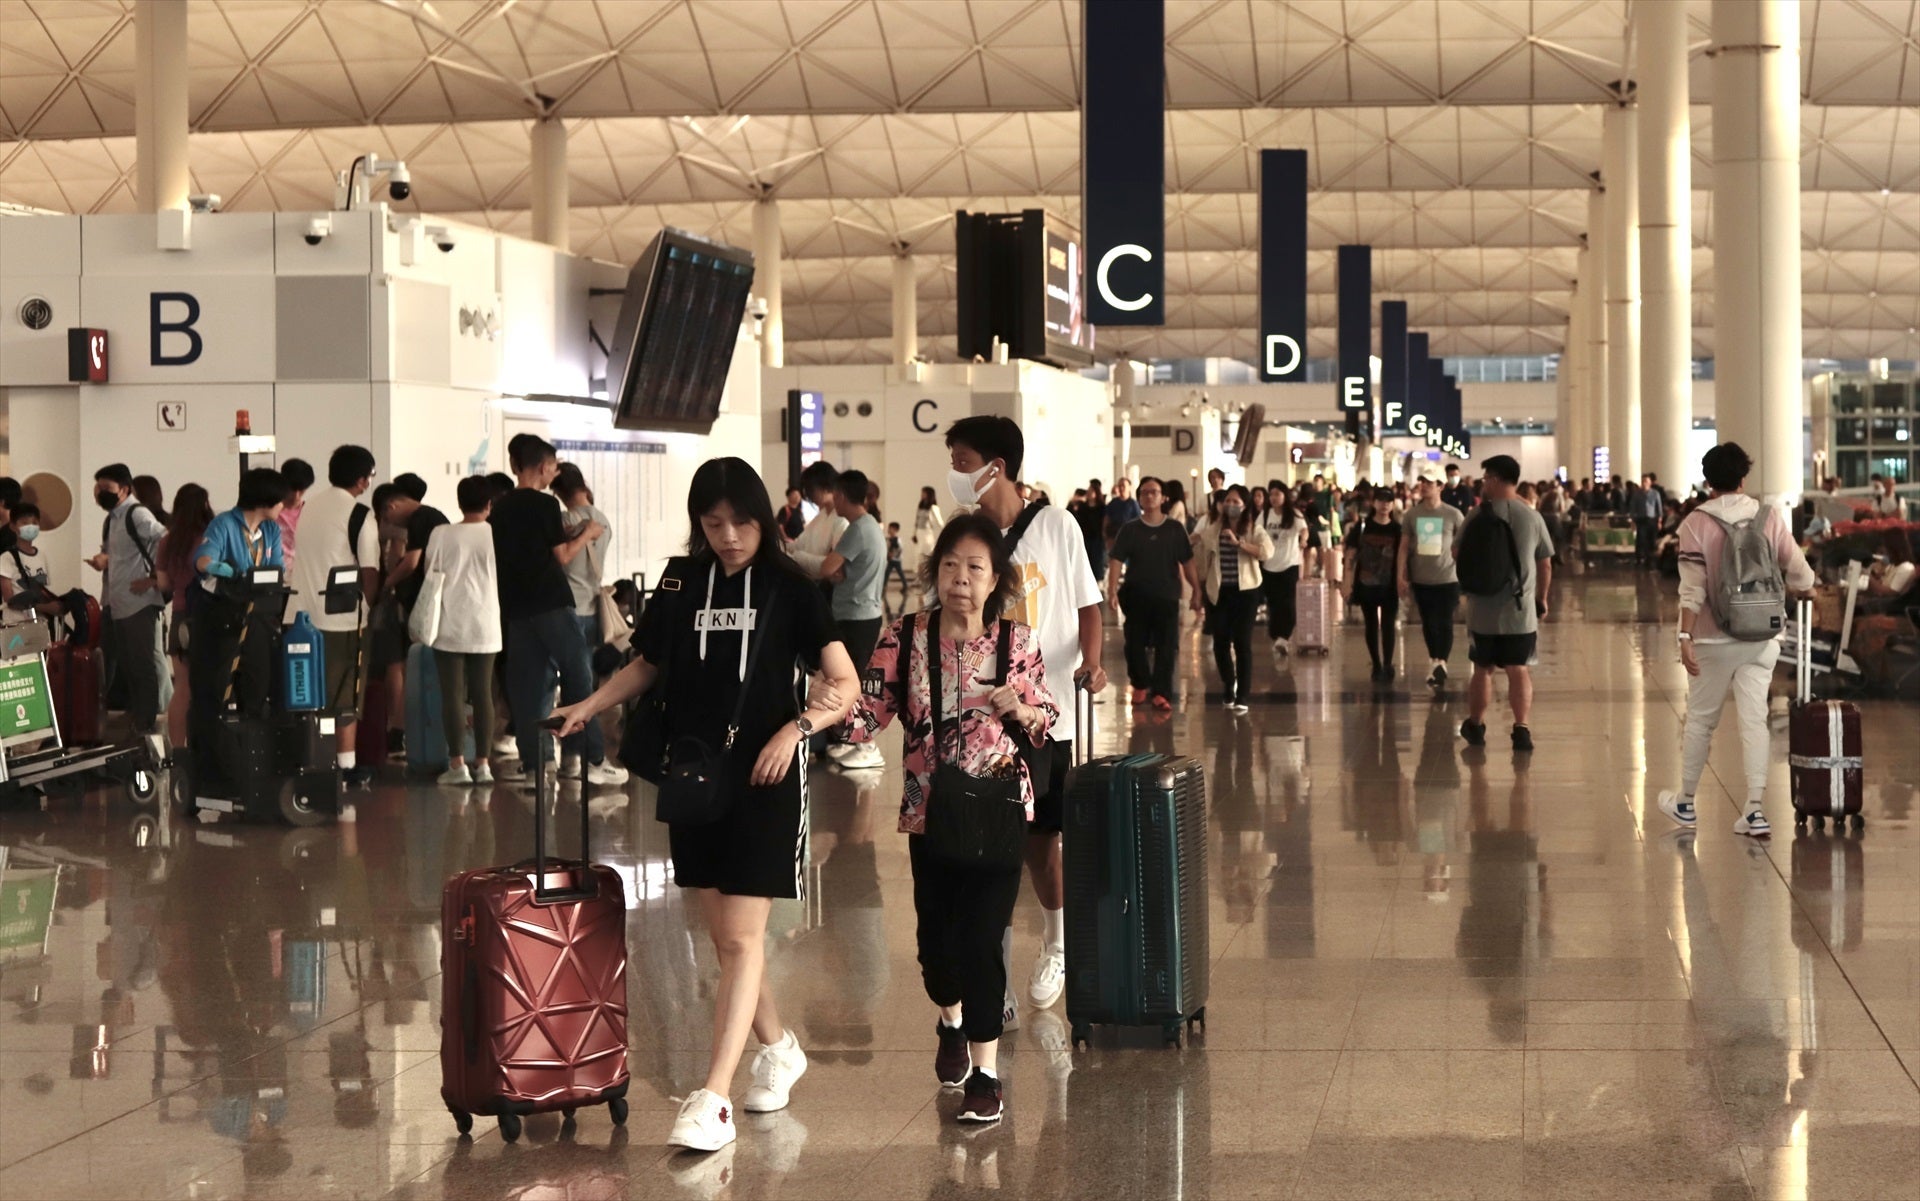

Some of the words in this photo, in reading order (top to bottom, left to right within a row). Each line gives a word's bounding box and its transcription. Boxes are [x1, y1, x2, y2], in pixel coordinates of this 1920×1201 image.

[1097, 244, 1153, 311] C
[150, 292, 203, 366] B
[1266, 335, 1301, 375] D
[1344, 376, 1365, 407] E
[912, 400, 938, 433] C
[1386, 402, 1403, 426] F
[1408, 414, 1428, 436] G
[1176, 429, 1195, 452] D
[1427, 428, 1443, 445] H
[1443, 435, 1454, 452] J
[1460, 445, 1470, 459] L
[294, 660, 306, 702] LITHIUM
